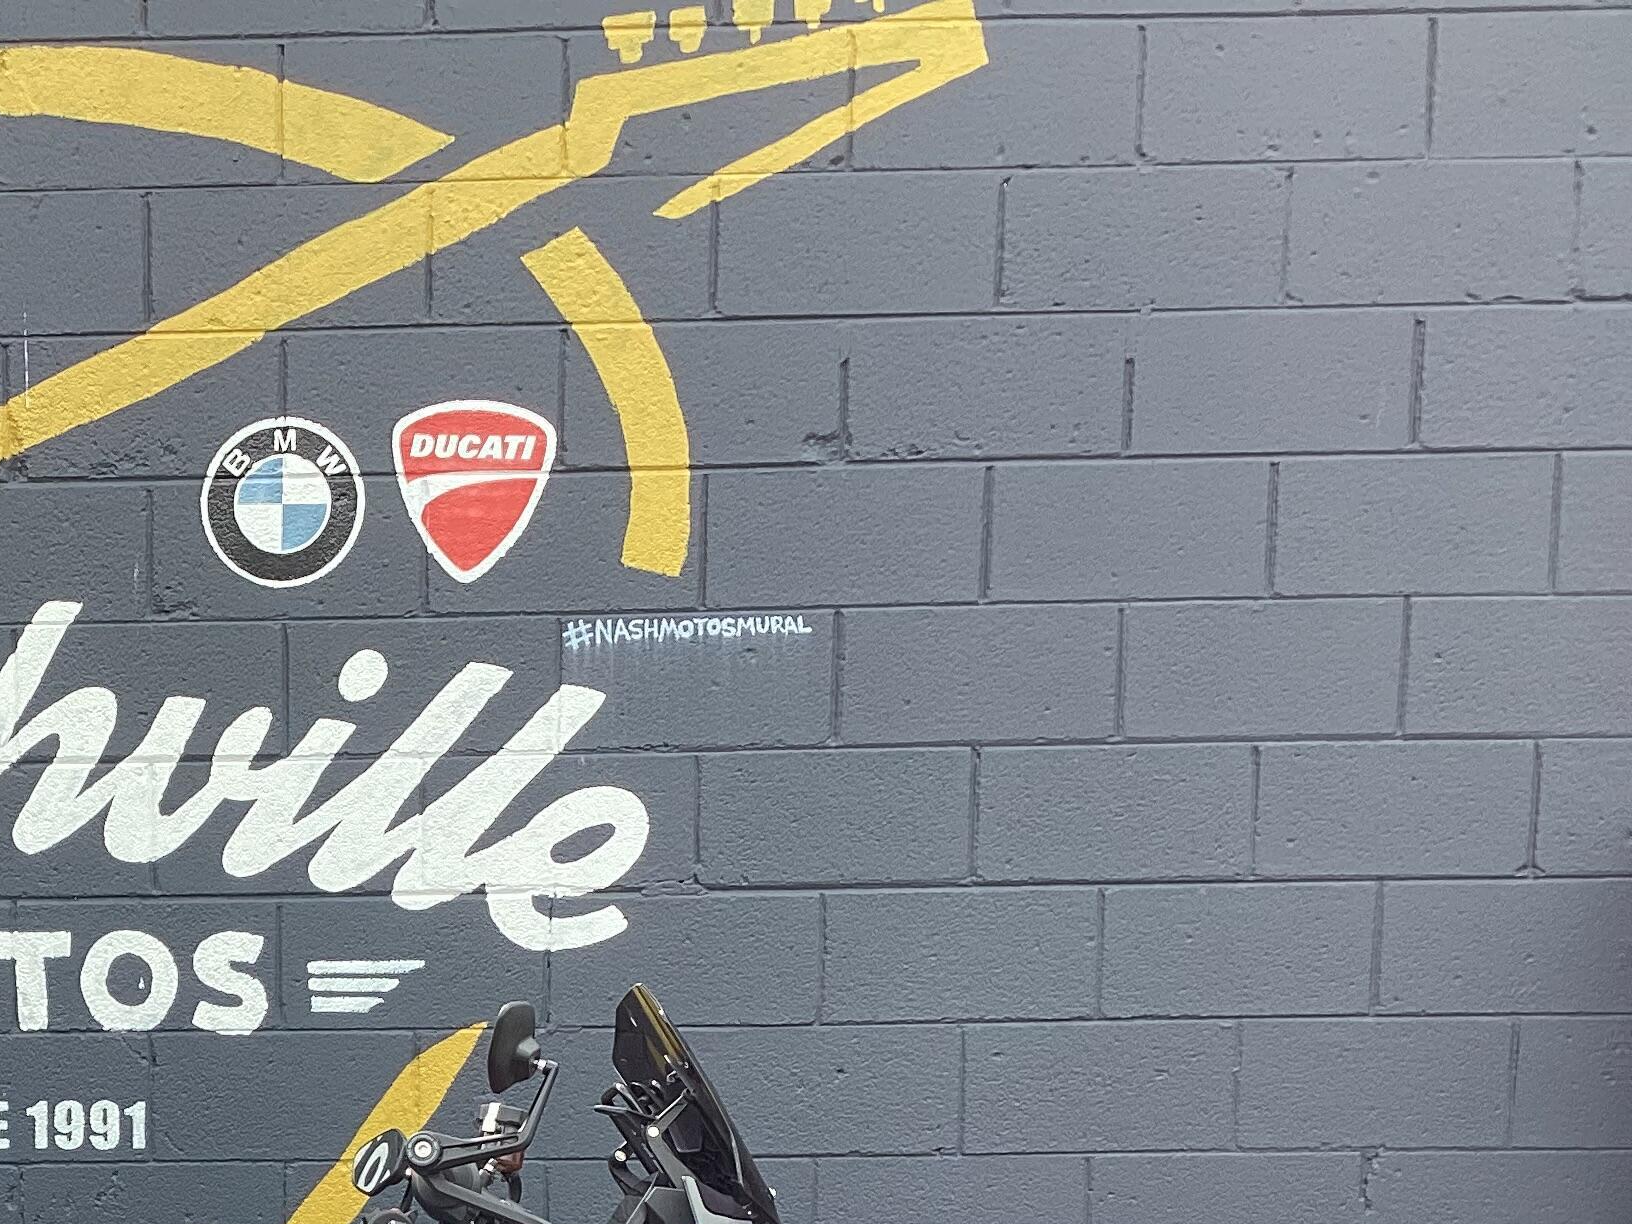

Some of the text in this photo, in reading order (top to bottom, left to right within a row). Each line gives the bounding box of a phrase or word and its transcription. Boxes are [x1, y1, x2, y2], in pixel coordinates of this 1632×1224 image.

[223, 427, 348, 477] BMW
[409, 432, 537, 461] DUCATI
[562, 615, 813, 650] #NASHMOTOSMURAL
[26, 1099, 147, 1151] 1991
